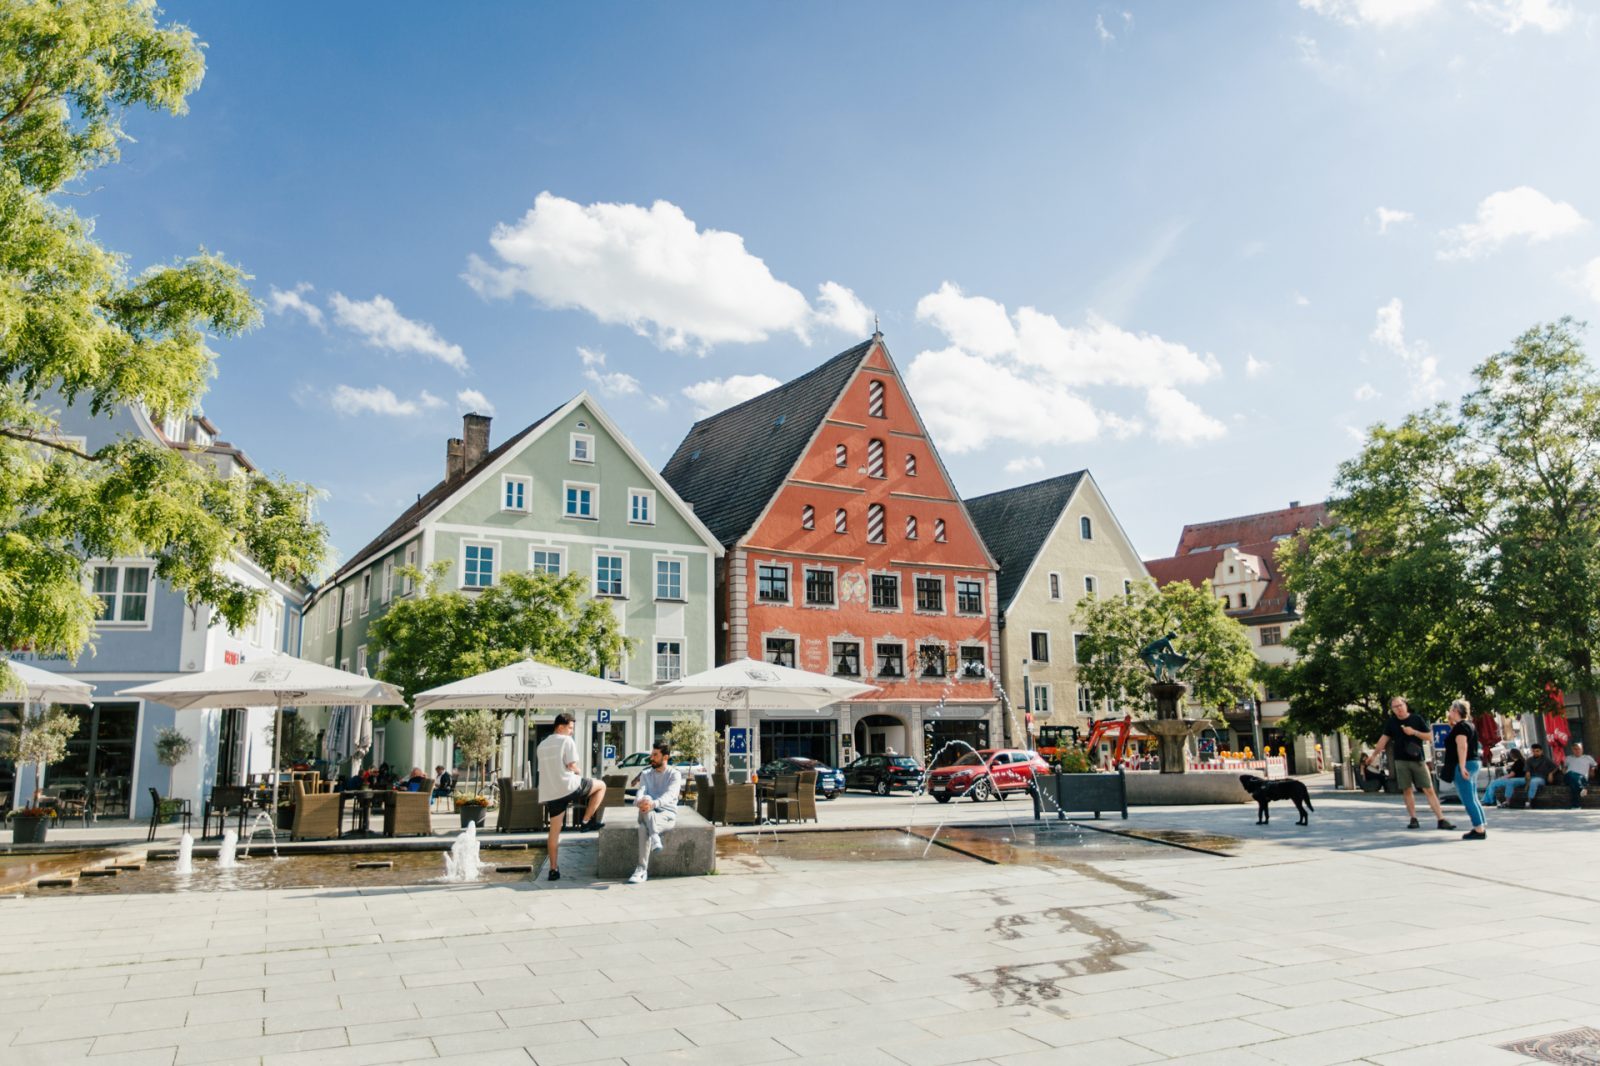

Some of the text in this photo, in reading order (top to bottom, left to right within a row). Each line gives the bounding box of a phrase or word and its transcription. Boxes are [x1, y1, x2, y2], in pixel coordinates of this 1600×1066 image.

[38, 653, 70, 661] LOUNG
[600, 710, 608, 722] P
[605, 747, 613, 758] P
